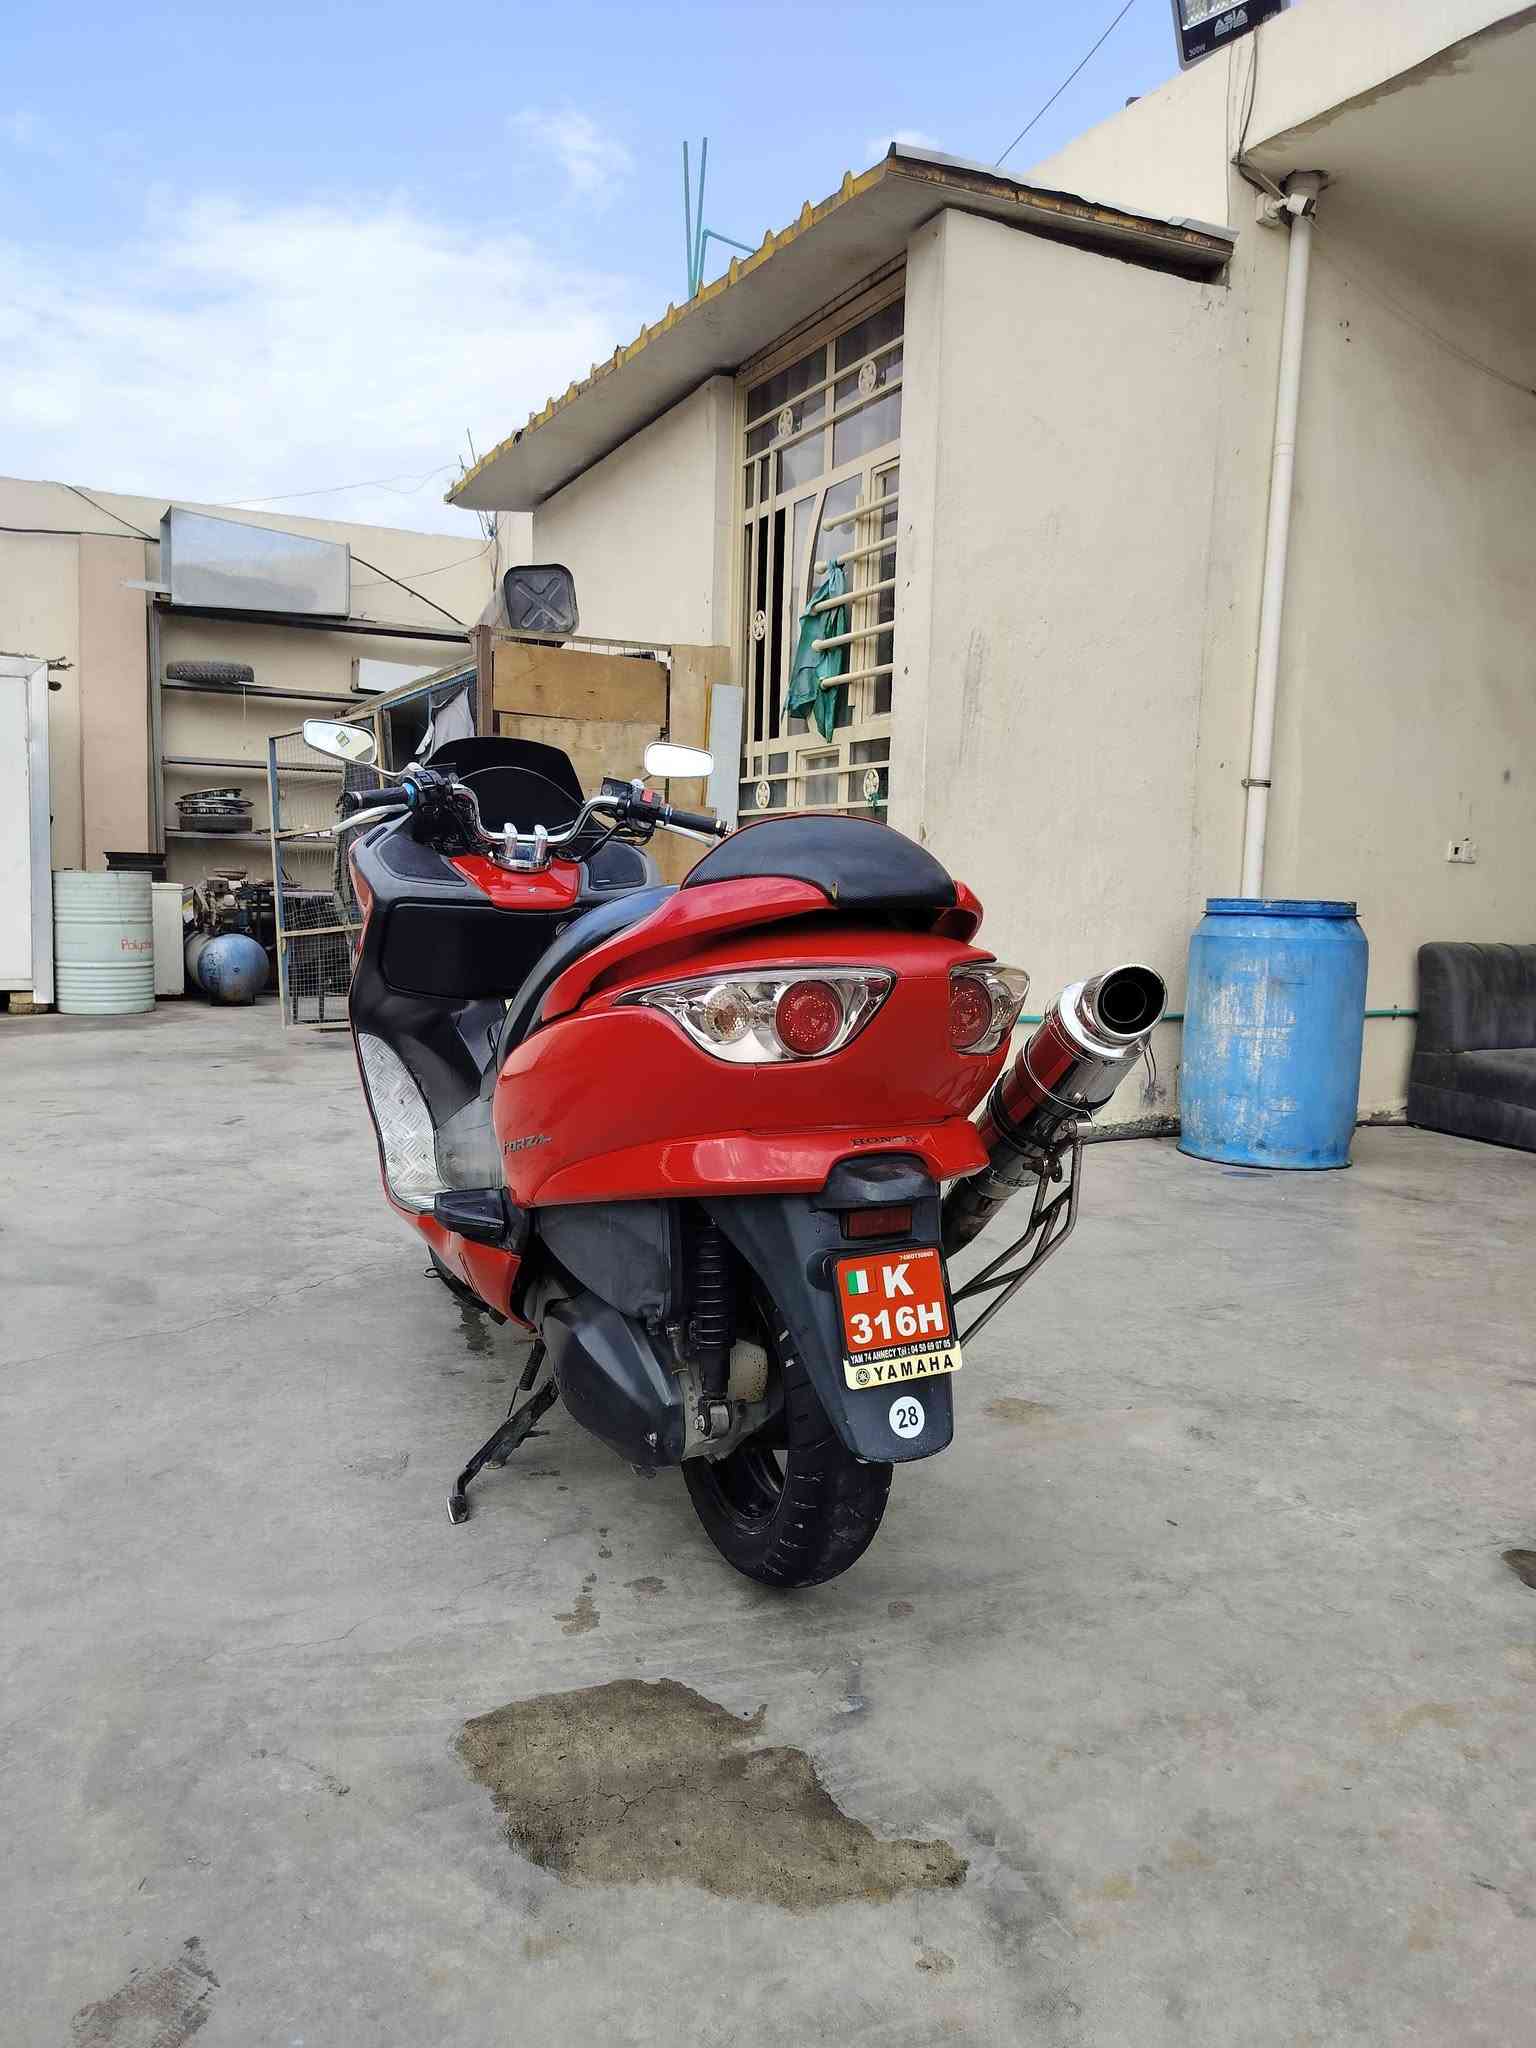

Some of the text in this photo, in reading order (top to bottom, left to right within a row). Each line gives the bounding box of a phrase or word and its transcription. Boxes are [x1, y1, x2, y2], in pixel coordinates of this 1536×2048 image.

[882, 1263, 914, 1299] K
[850, 1301, 944, 1345] 316H
[850, 1353, 864, 1364] YAM
[864, 1352, 872, 1362] 74
[872, 1347, 897, 1361] ANNECY
[910, 1344, 919, 1354] 04
[873, 1353, 954, 1381] YAMAHA
[896, 1405, 919, 1429] 28
